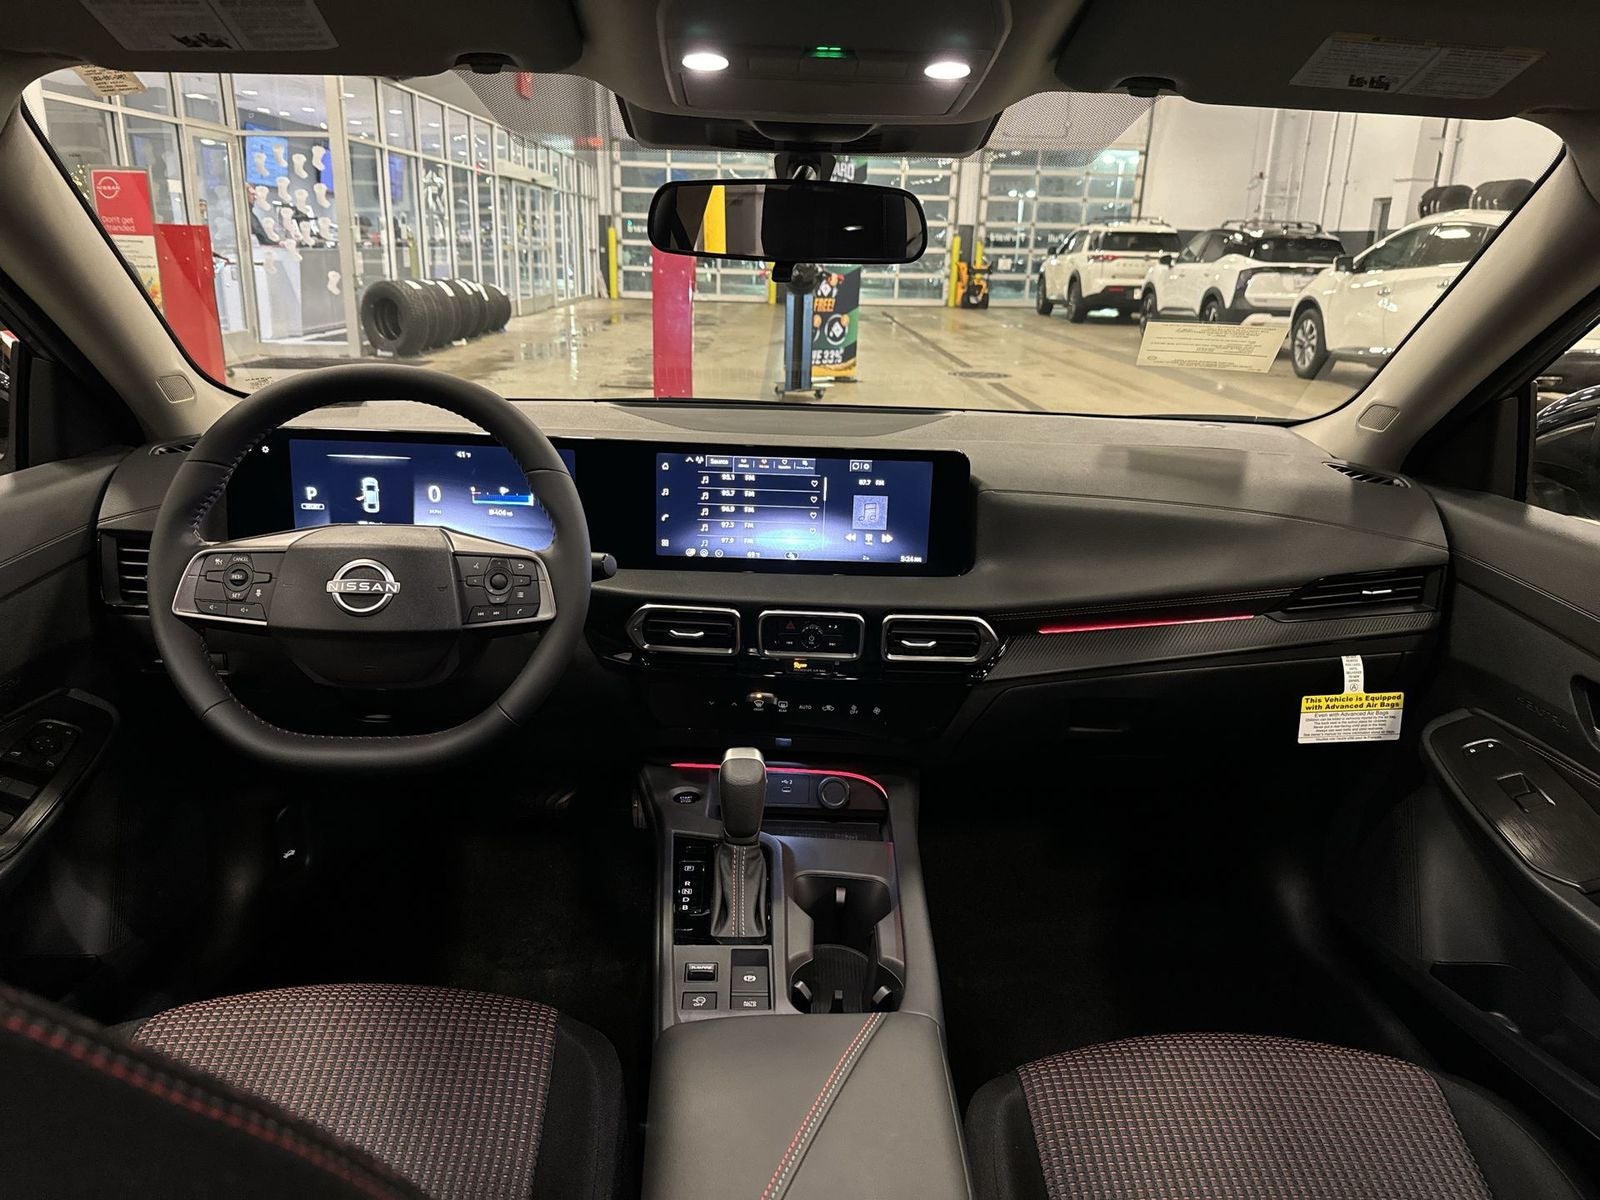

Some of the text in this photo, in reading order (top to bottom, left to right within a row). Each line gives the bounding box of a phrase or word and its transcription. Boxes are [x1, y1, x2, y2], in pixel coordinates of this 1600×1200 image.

[833, 161, 855, 180] ARD
[305, 486, 317, 500] P
[428, 485, 441, 503] 0
[328, 582, 397, 592] NISSAN
[1365, 694, 1401, 702] Equipped
[1380, 701, 1400, 709] Bags
